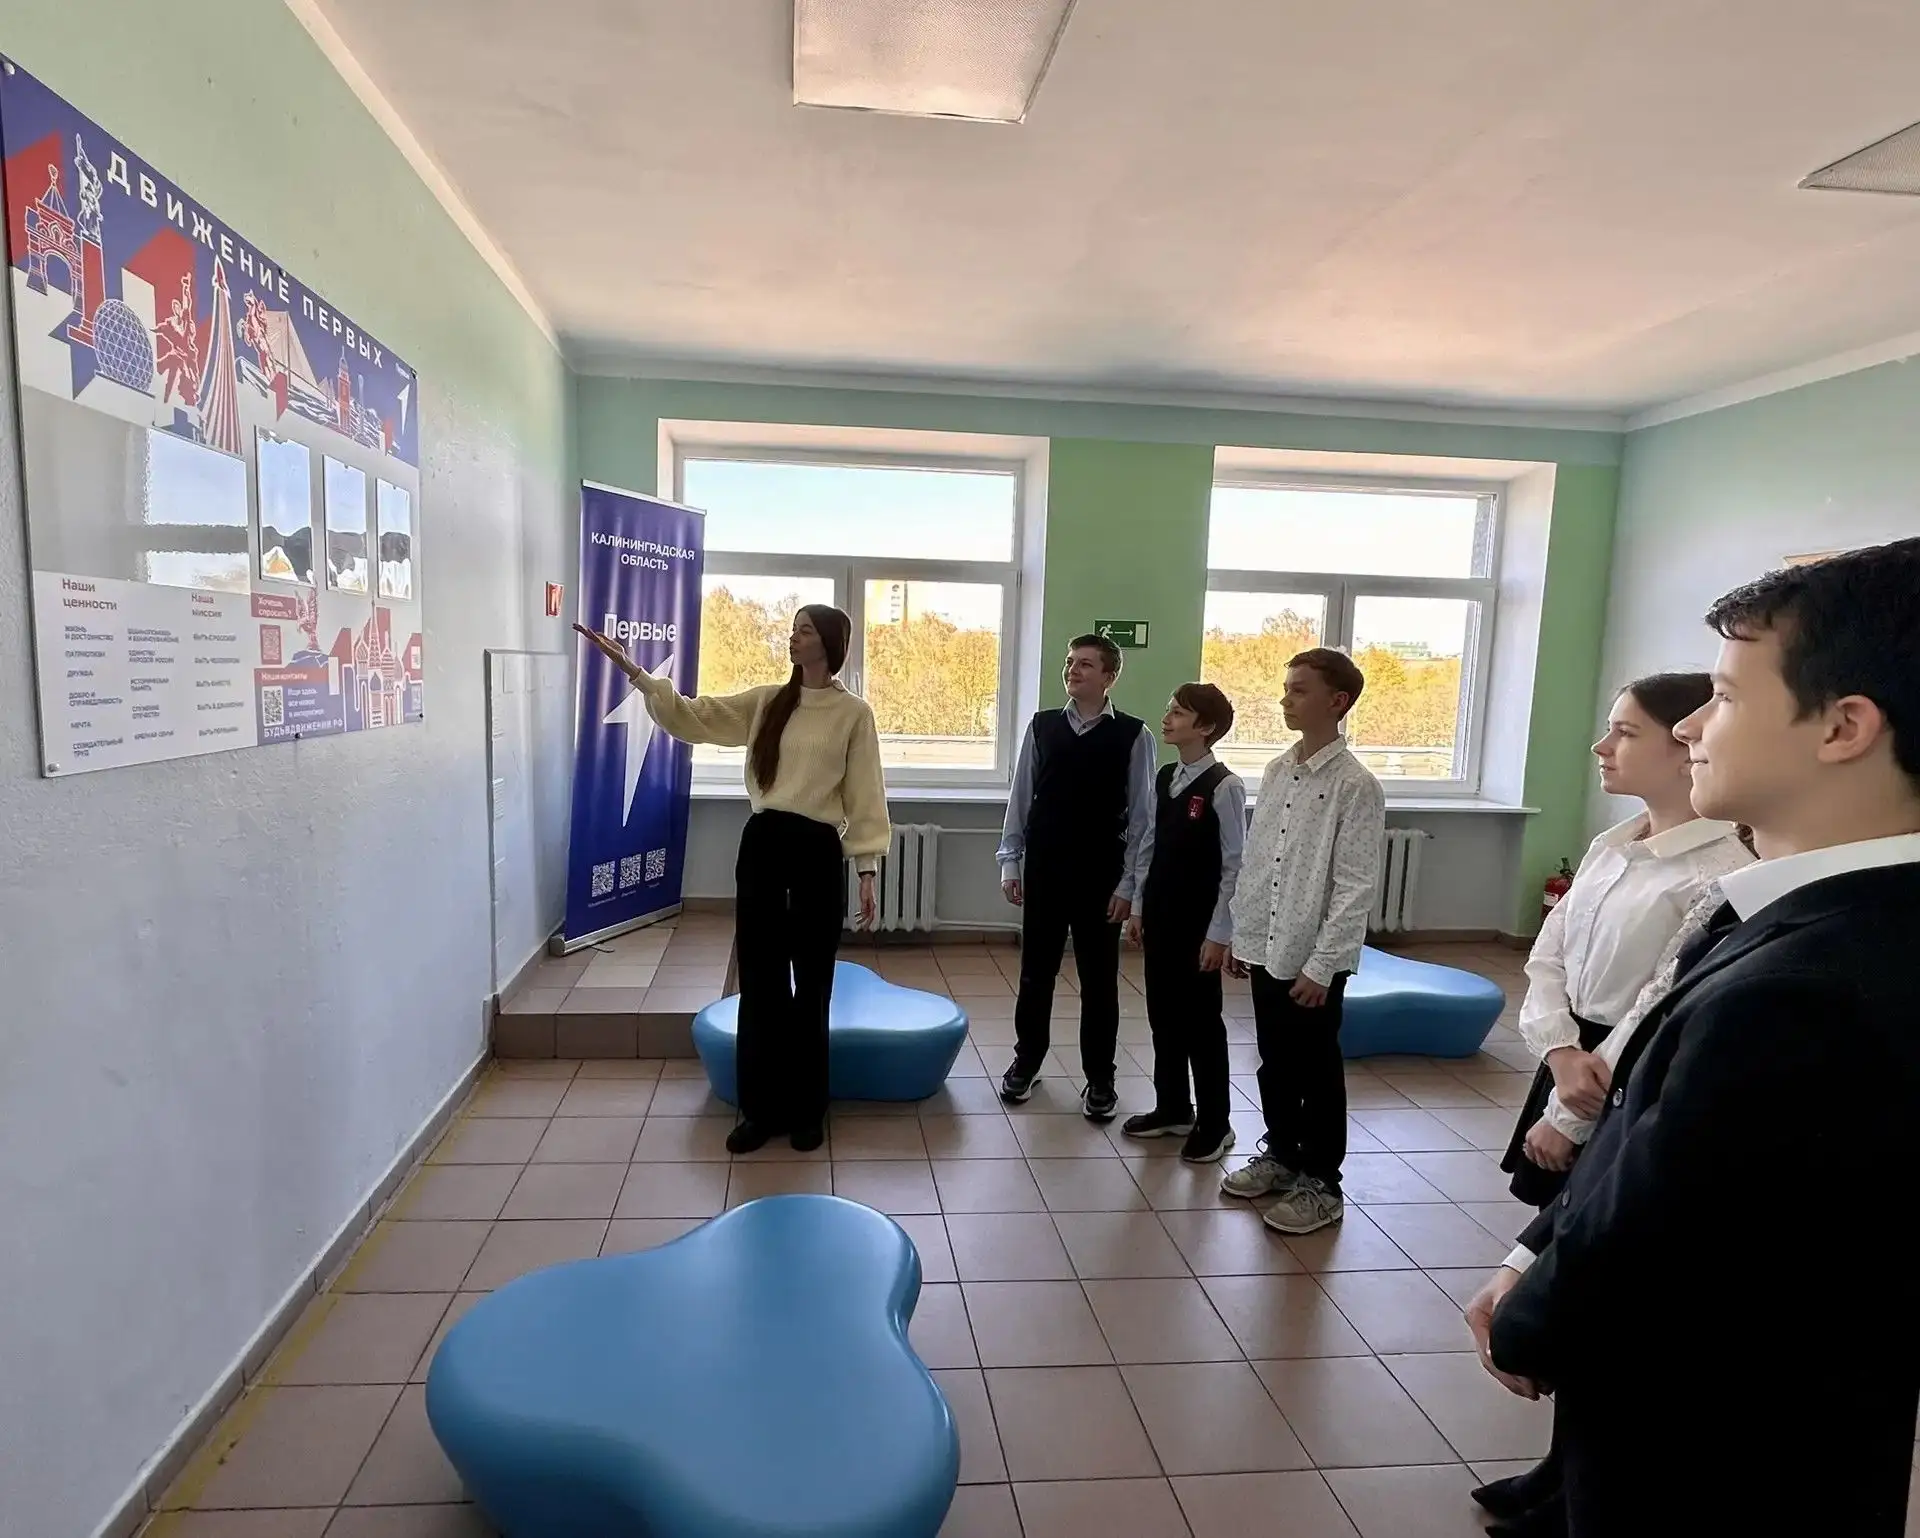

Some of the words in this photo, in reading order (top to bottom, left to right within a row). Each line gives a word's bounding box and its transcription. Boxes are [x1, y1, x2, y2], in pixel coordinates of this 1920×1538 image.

[107, 151, 290, 304] ДВИЖЕНИЕ
[302, 295, 383, 369] ПЕРВЫХ
[591, 532, 696, 560] КАЛИНИНГРАДСКАЯ
[621, 554, 669, 571] ОБЛАСТЬ
[63, 578, 96, 592] Наши
[63, 597, 118, 610] ценности
[191, 593, 214, 604] Наша
[604, 613, 677, 647] Первые
